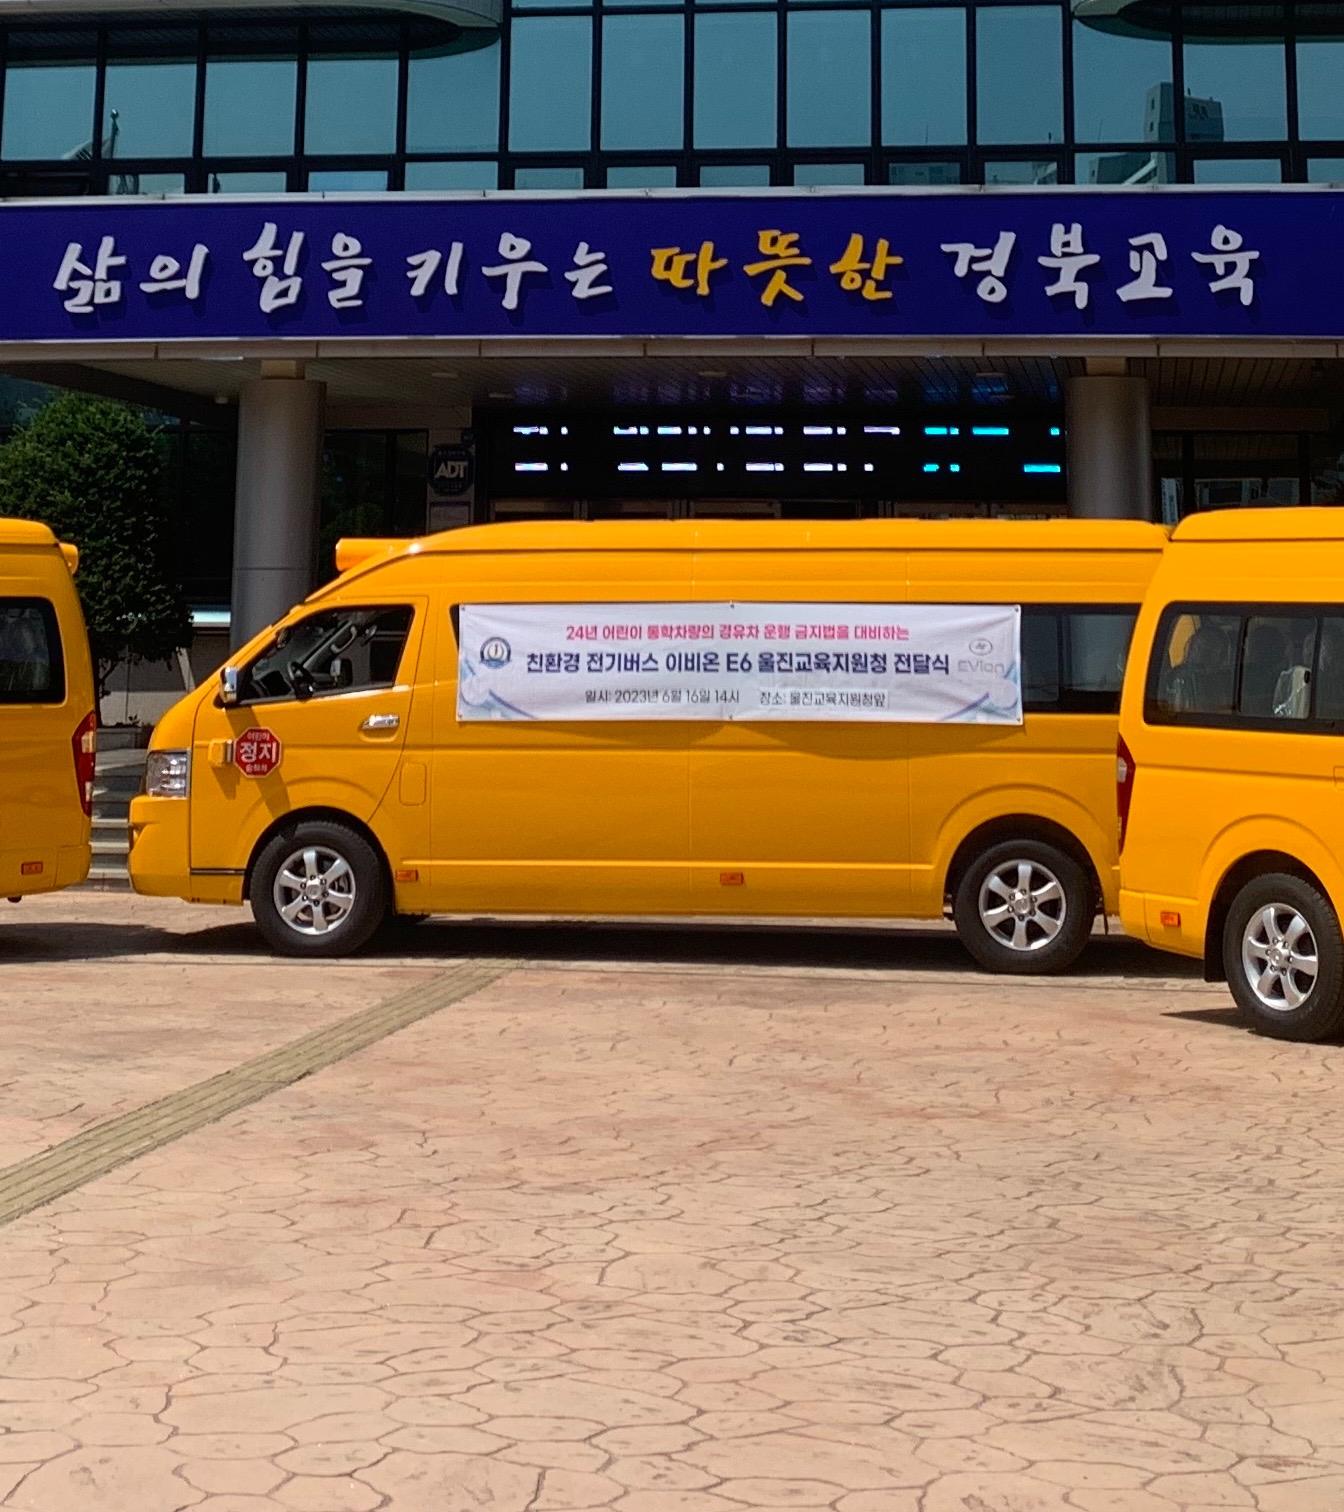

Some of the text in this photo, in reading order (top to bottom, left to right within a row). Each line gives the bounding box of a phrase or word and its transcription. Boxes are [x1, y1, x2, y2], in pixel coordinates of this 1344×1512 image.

[53, 222, 1259, 313] 삶의 힘을 키우는 따뜻한 경북교육
[434, 460, 468, 478] ADT
[566, 624, 909, 641] 24년 어린이 통학차량의 경유차 운행 금지법을 대비하는
[527, 652, 949, 675] 친환경 전기버스 이비온 E6 울진교육지원청 전달식
[615, 690, 659, 704] 2023년
[662, 690, 682, 704] 6월
[686, 690, 711, 704] 16일
[715, 690, 739, 704] 14시
[240, 741, 276, 763] 정지
